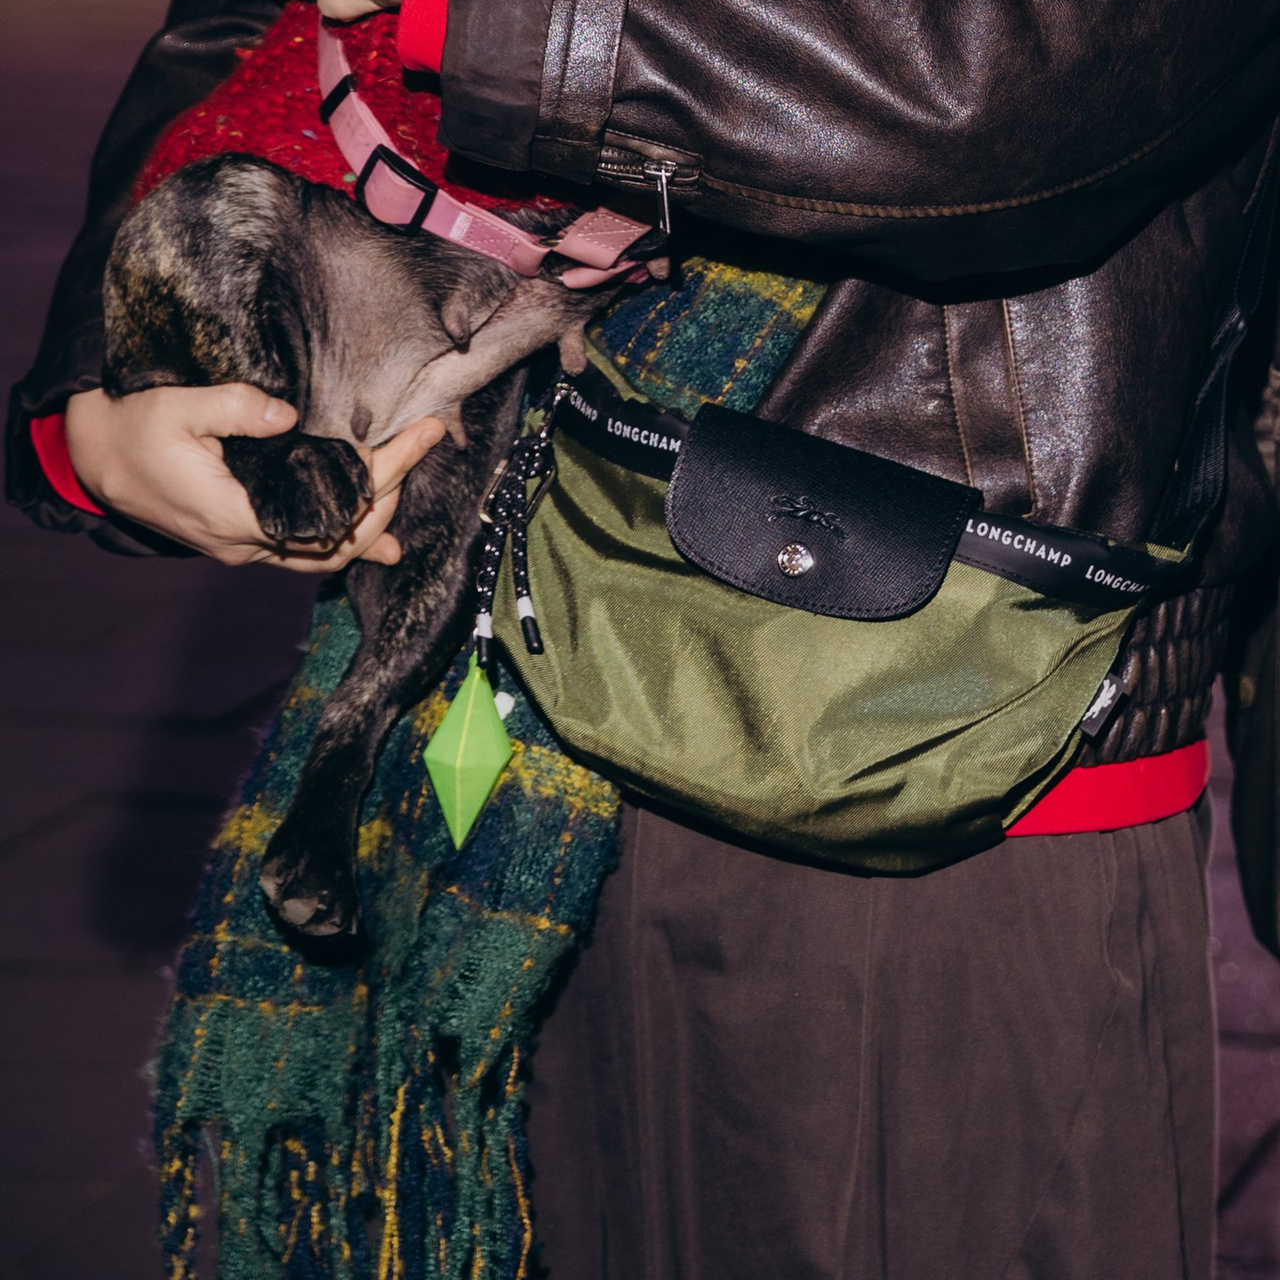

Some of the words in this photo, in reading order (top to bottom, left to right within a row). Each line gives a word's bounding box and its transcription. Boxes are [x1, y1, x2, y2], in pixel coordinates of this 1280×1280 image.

[570, 386, 599, 422] CHAMP
[965, 519, 1072, 568] LONGCHAMP
[1085, 565, 1150, 593] LONGCHA
